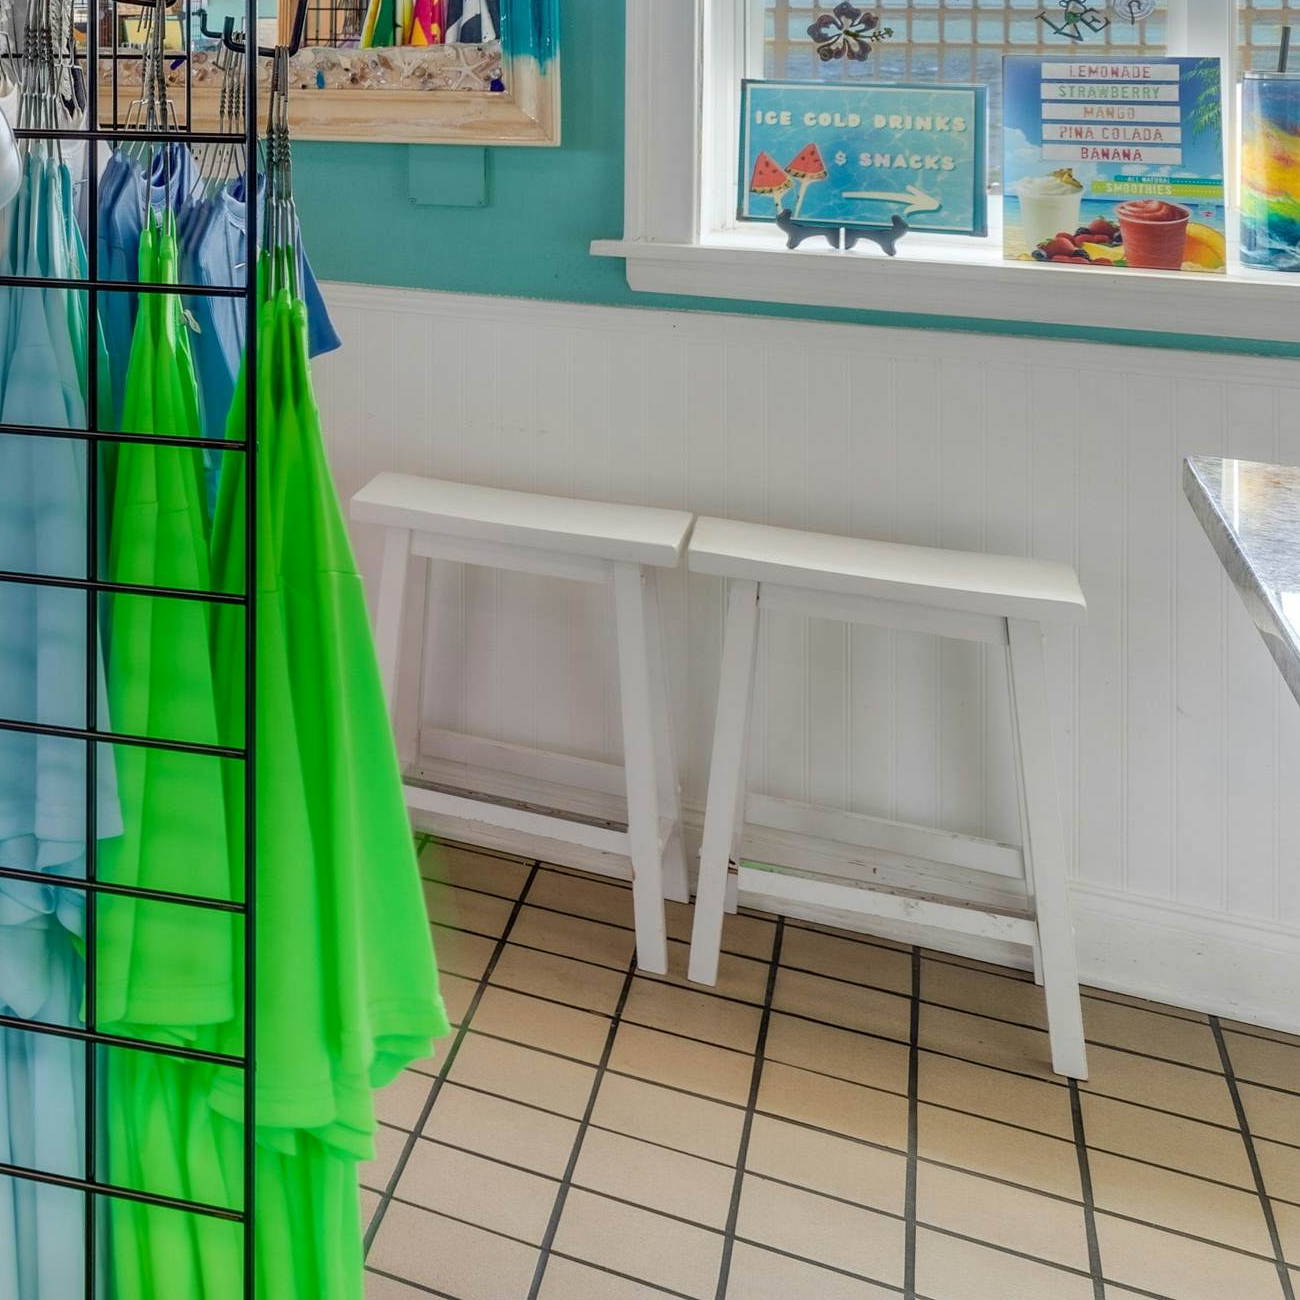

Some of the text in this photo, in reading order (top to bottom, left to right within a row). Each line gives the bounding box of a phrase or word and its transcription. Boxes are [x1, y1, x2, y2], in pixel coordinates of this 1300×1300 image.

[1069, 65, 1151, 79] LEMONADE
[1058, 85, 1160, 99] STRAWBERRY
[1083, 106, 1135, 119] MANGO
[755, 110, 967, 132] ICE COLD DRINKS
[1059, 126, 1163, 141] PINA COLADA
[1081, 147, 1143, 161] BANANA
[859, 152, 956, 171] SNACKS
[1105, 183, 1172, 196] SMOOTHIES
